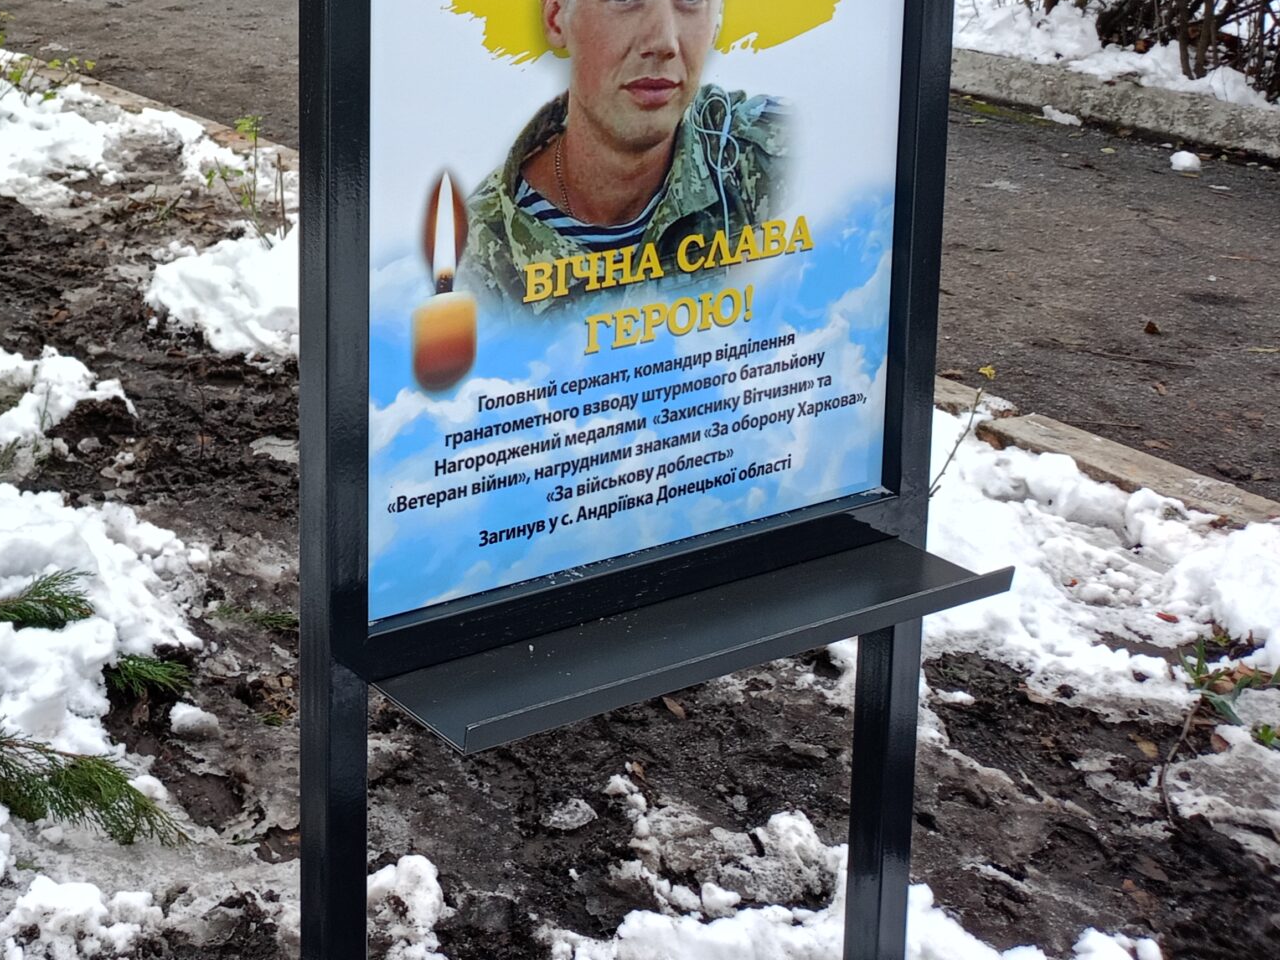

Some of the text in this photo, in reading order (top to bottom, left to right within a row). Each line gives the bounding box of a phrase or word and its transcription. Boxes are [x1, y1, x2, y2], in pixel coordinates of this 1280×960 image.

[522, 215, 814, 304] ВІЧНА СЛАВА
[583, 284, 755, 356] ГЕРОЮ!
[444, 351, 825, 450] гранатометного взводу штурмового батальйону
[478, 333, 796, 413] Головний сержант, командир відділення
[387, 392, 868, 514] «Ветеран війни», нагрудними знаками «За оборону Харкова»,
[434, 374, 833, 477] Нагороджений медалями «Захиснику Вітчизни» та
[478, 453, 793, 548] Загинув у с. Андріївка Донецької області
[545, 448, 734, 503] «За військову доблесть»
